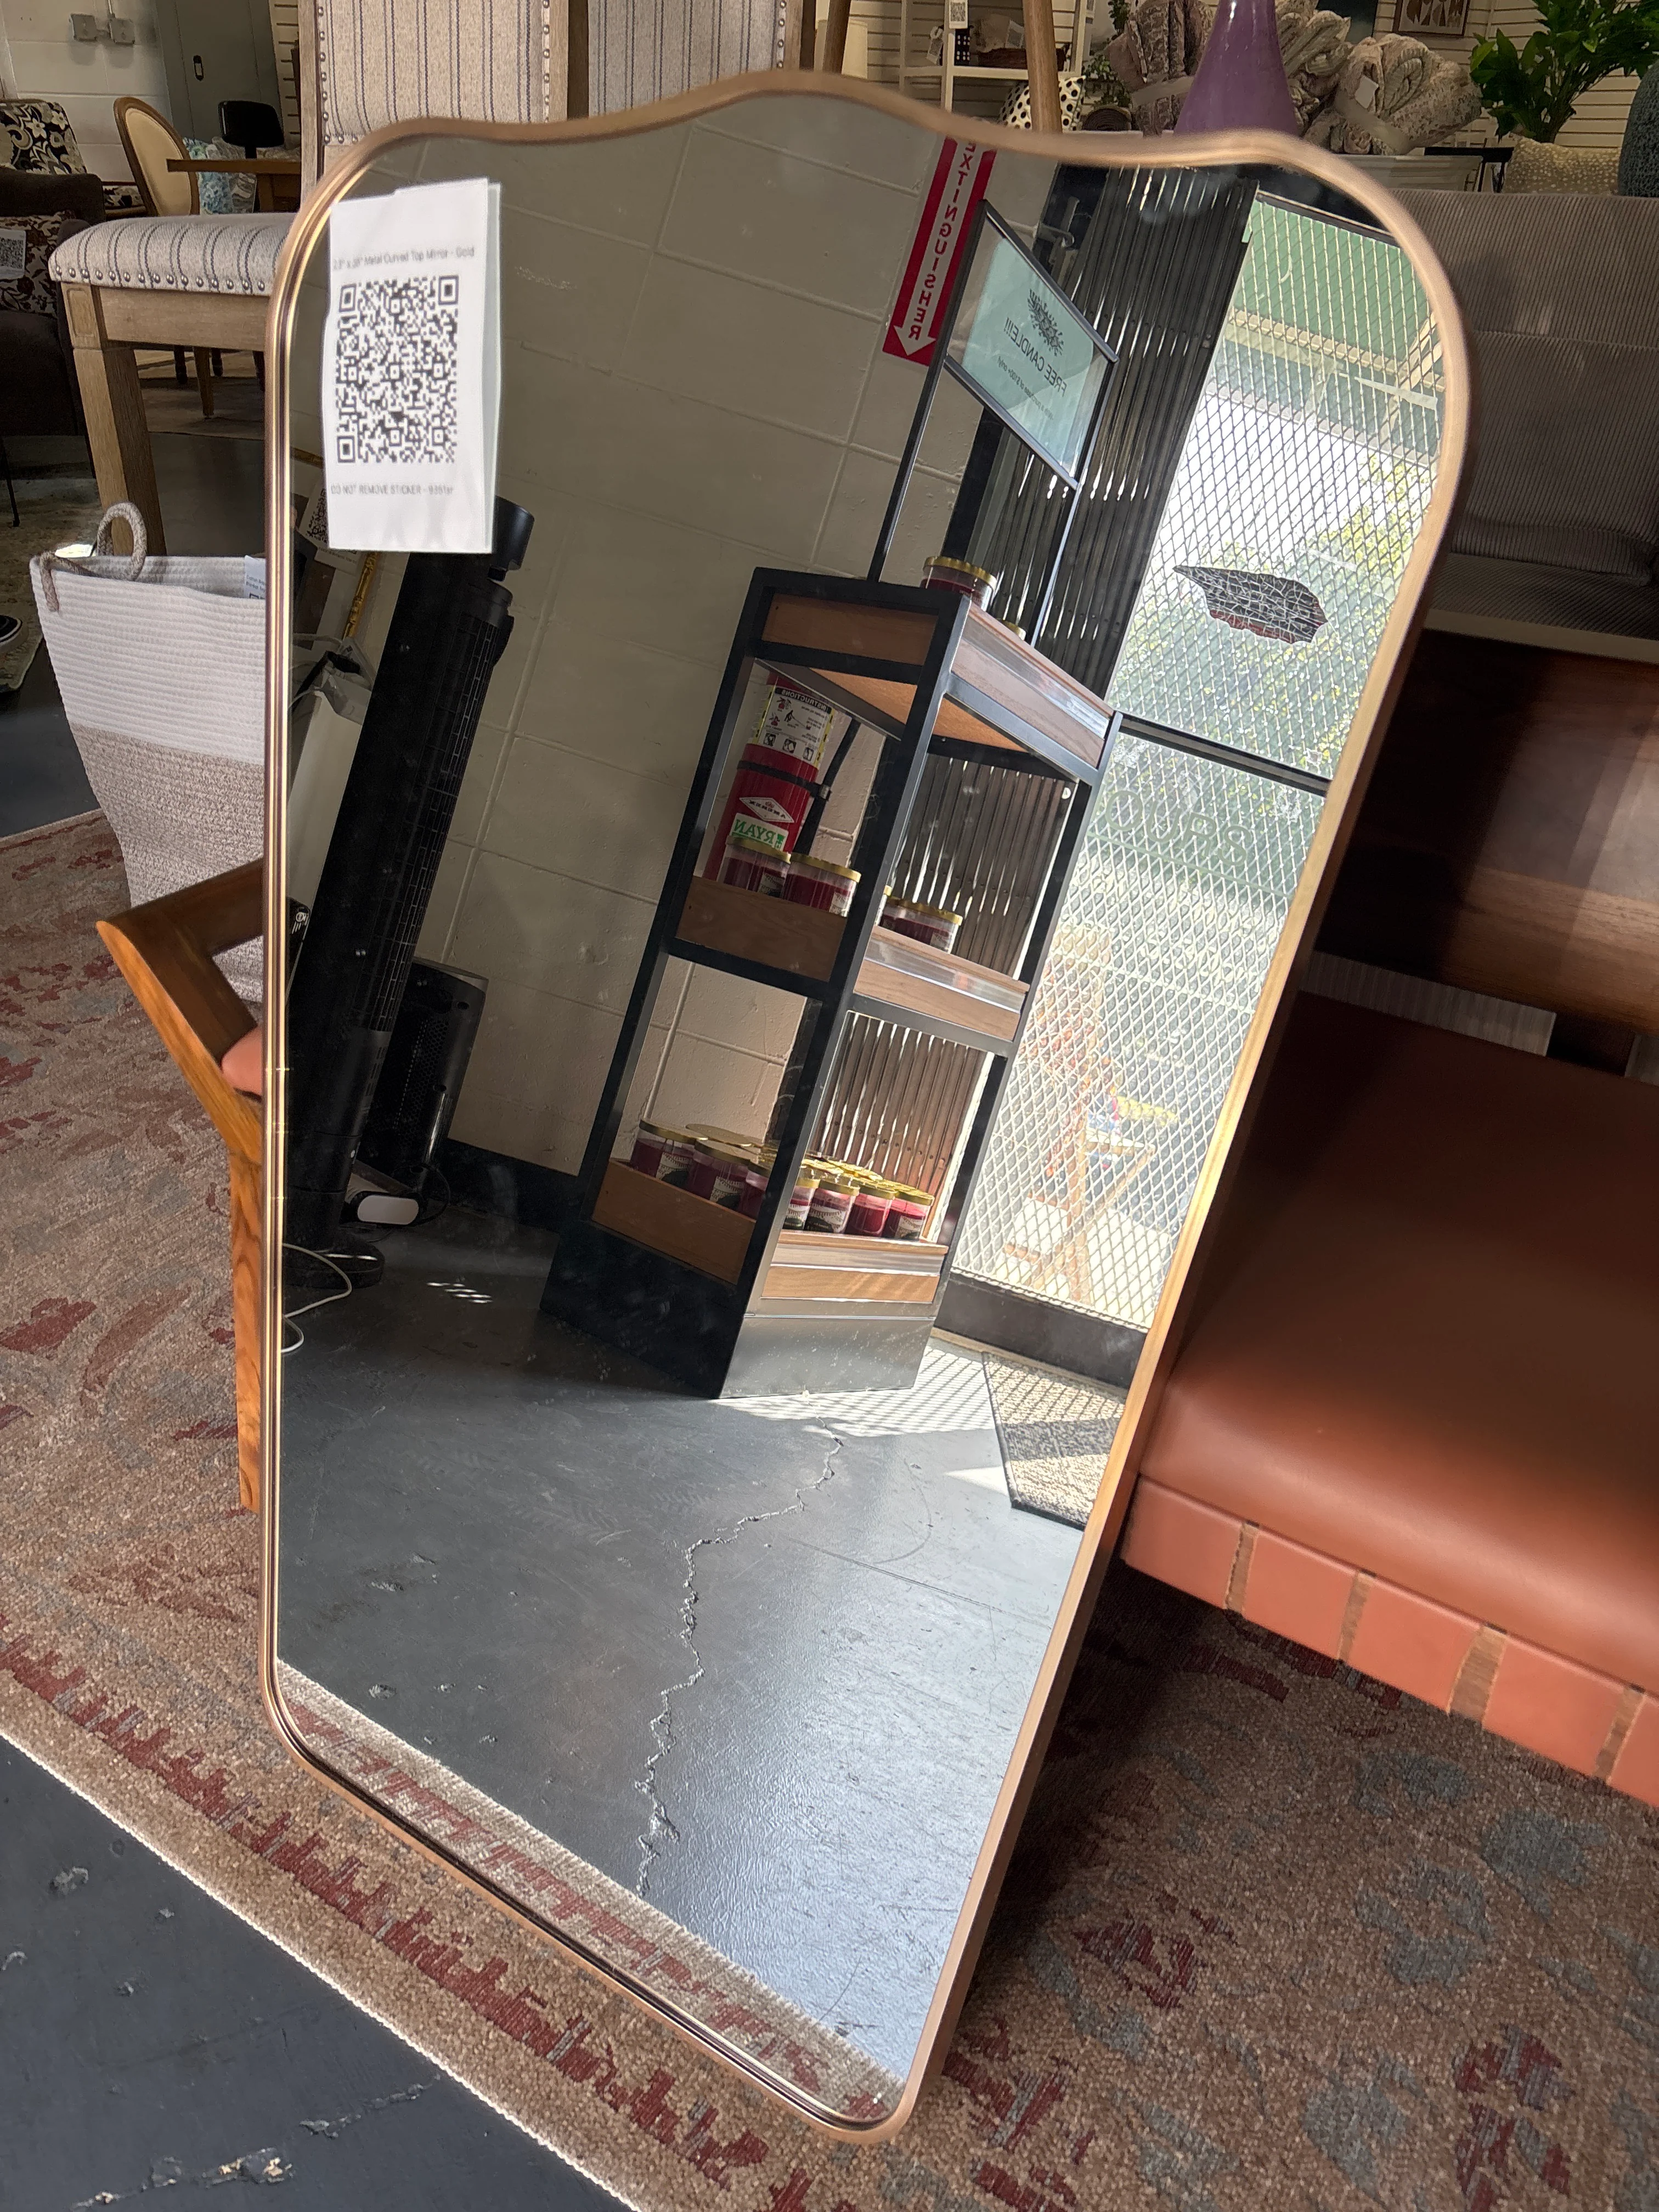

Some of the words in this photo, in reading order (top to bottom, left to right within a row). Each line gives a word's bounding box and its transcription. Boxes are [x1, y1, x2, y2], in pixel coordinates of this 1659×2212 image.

[383, 253, 408, 264] Curved
[410, 250, 424, 262] Top
[426, 248, 448, 259] Mirror
[455, 245, 474, 257] Gold
[331, 483, 340, 494] DO
[342, 483, 356, 494] NOT
[359, 484, 387, 494] REMOVE
[390, 484, 421, 494] STICKER
[1091, 782, 1253, 866] OURS
